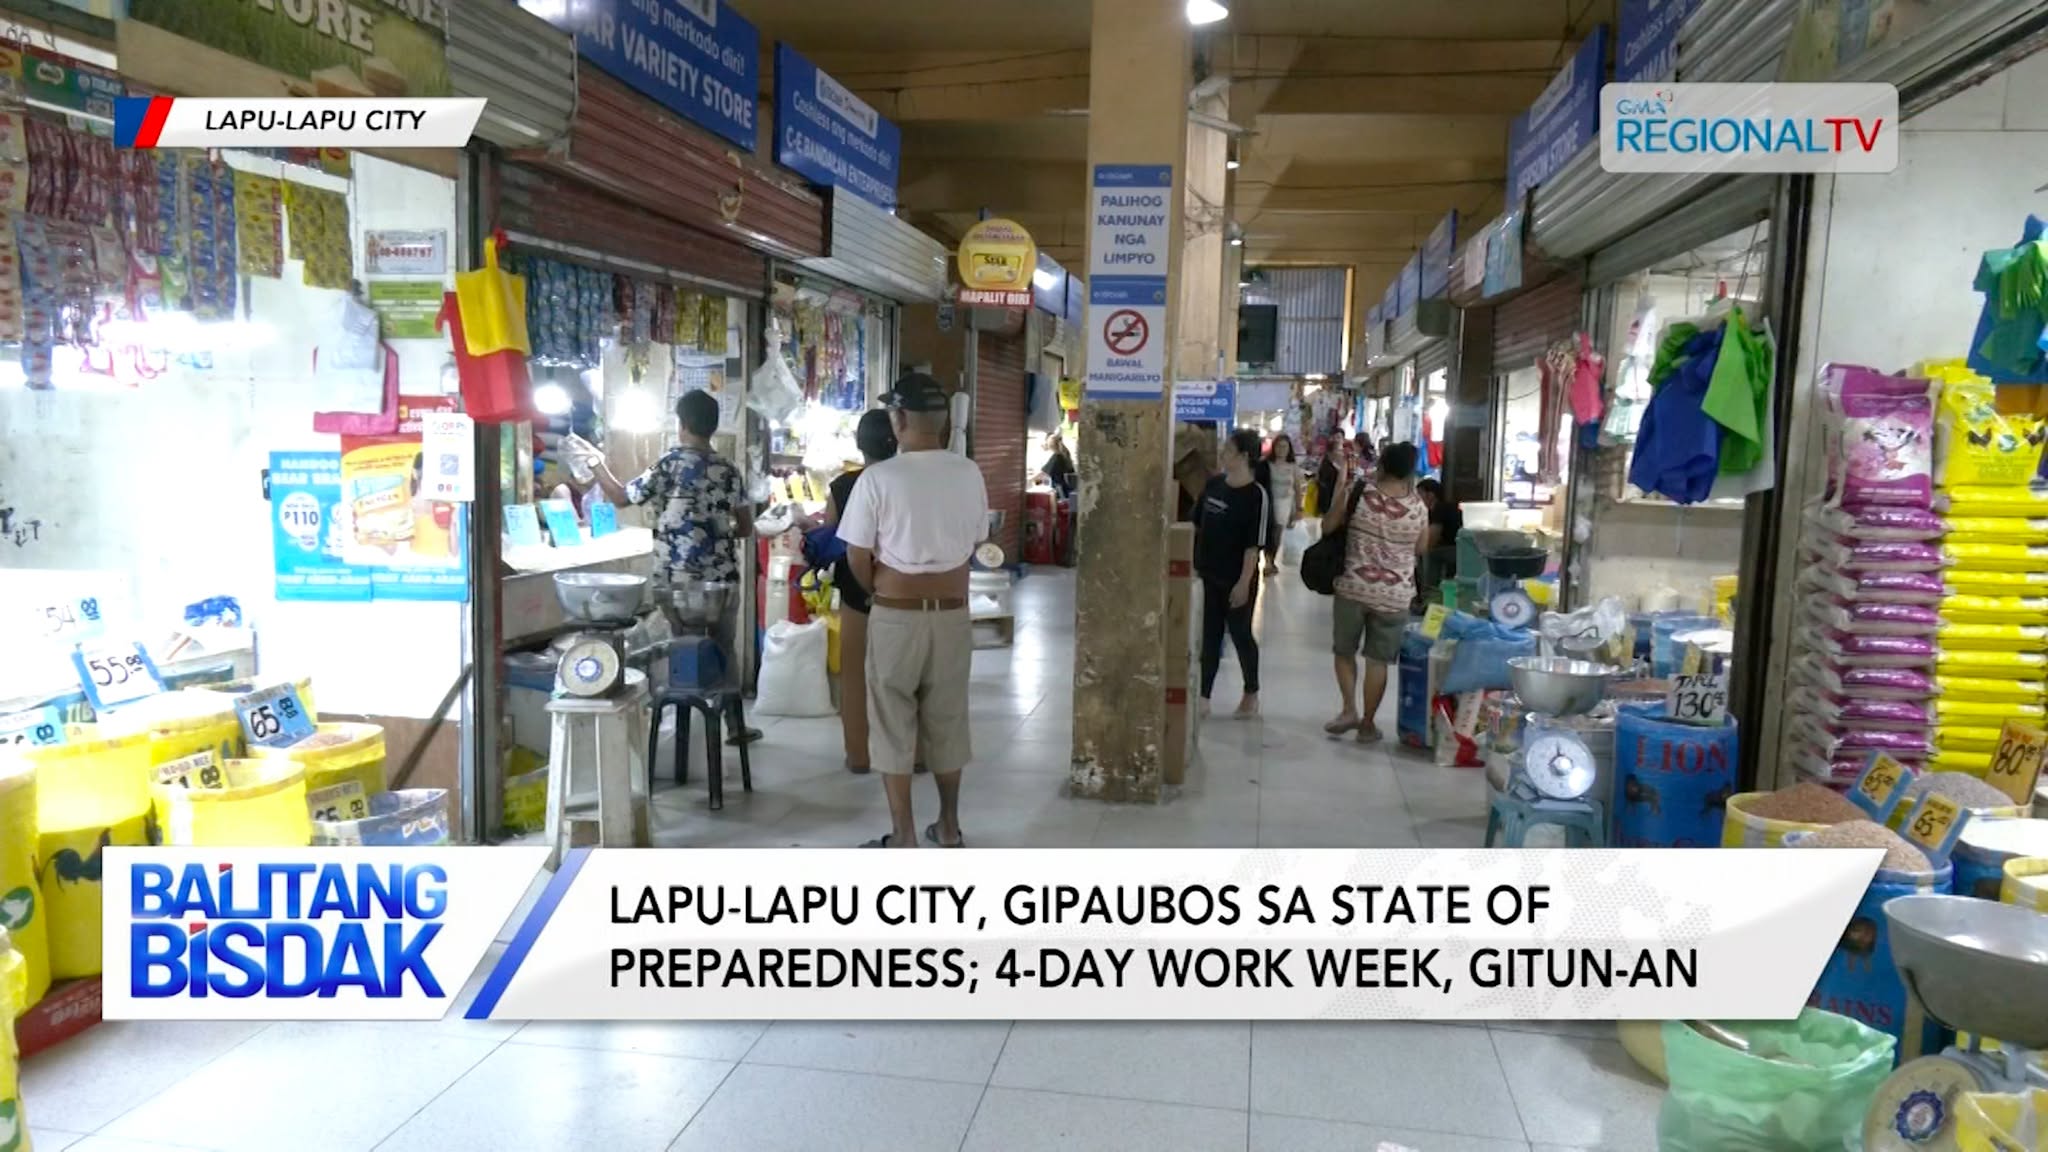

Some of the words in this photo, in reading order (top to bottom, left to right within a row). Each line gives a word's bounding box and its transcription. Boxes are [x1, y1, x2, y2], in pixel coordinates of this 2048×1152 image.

[621, 22, 699, 98] VARIETY
[702, 74, 752, 129] STORE
[1100, 195, 1163, 207] PALIHOG
[1097, 215, 1165, 227] KANUNAY
[1114, 234, 1146, 245] NGA
[1102, 253, 1156, 265] LIMPYO
[1106, 358, 1144, 369] BAWAL
[1636, 735, 1730, 777] LION
